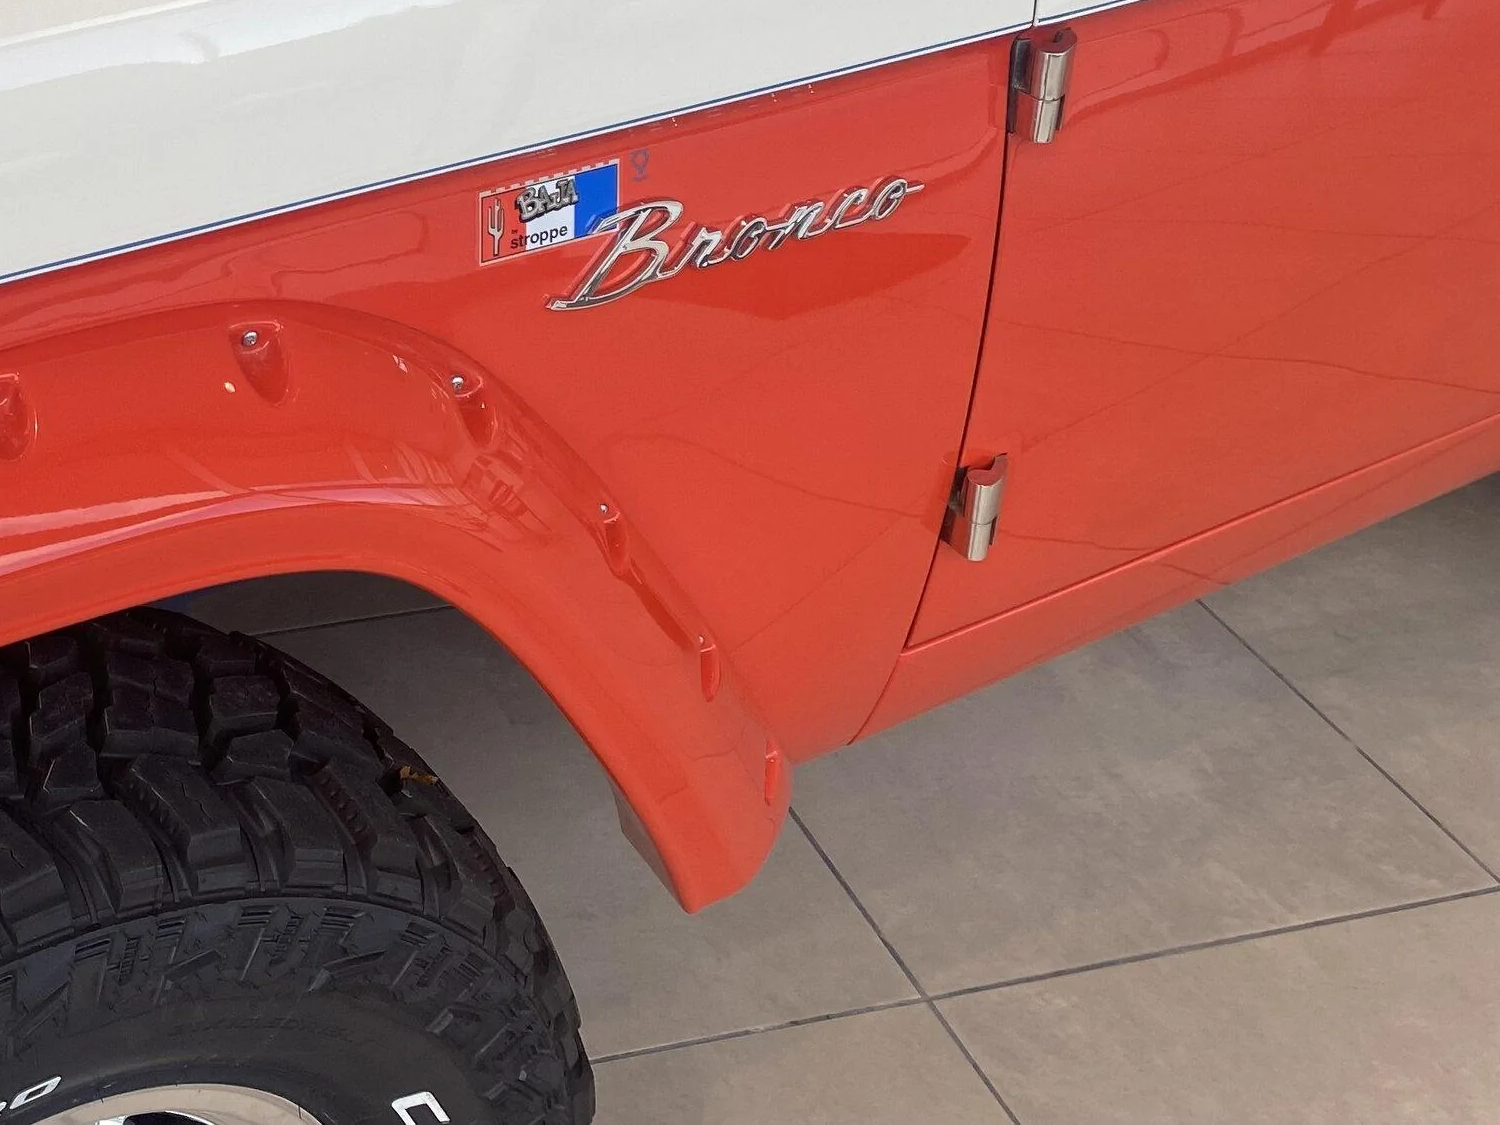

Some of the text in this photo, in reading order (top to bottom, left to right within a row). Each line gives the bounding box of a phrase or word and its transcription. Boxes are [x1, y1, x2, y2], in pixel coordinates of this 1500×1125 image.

[516, 178, 579, 223] BAJA
[510, 225, 568, 249] stroppe
[550, 178, 925, 311] Bronco
